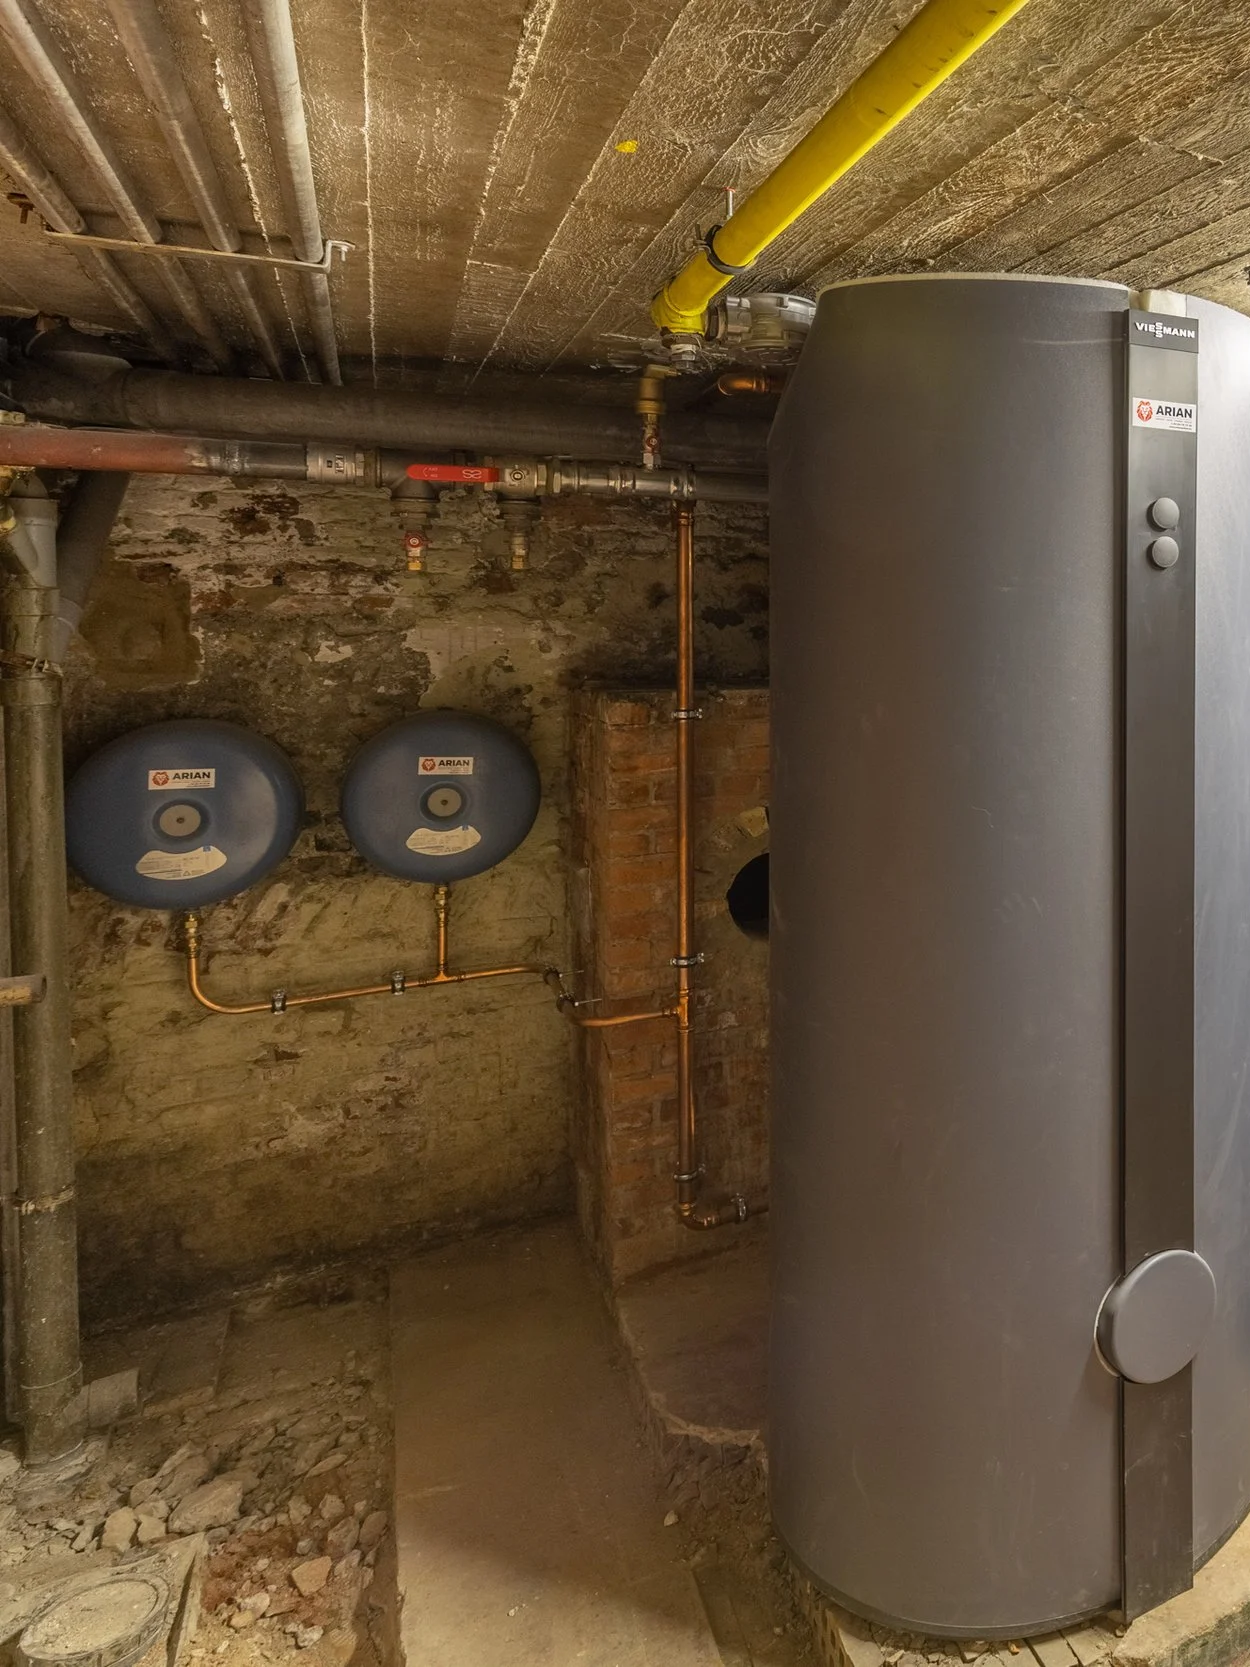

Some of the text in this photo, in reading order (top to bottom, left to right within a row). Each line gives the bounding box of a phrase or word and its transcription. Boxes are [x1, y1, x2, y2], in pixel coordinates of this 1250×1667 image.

[1134, 321, 1195, 338] VIESSMANN
[1156, 405, 1192, 418] ARIAN
[438, 759, 470, 767] ARIAN
[173, 771, 211, 780] ARIAN
